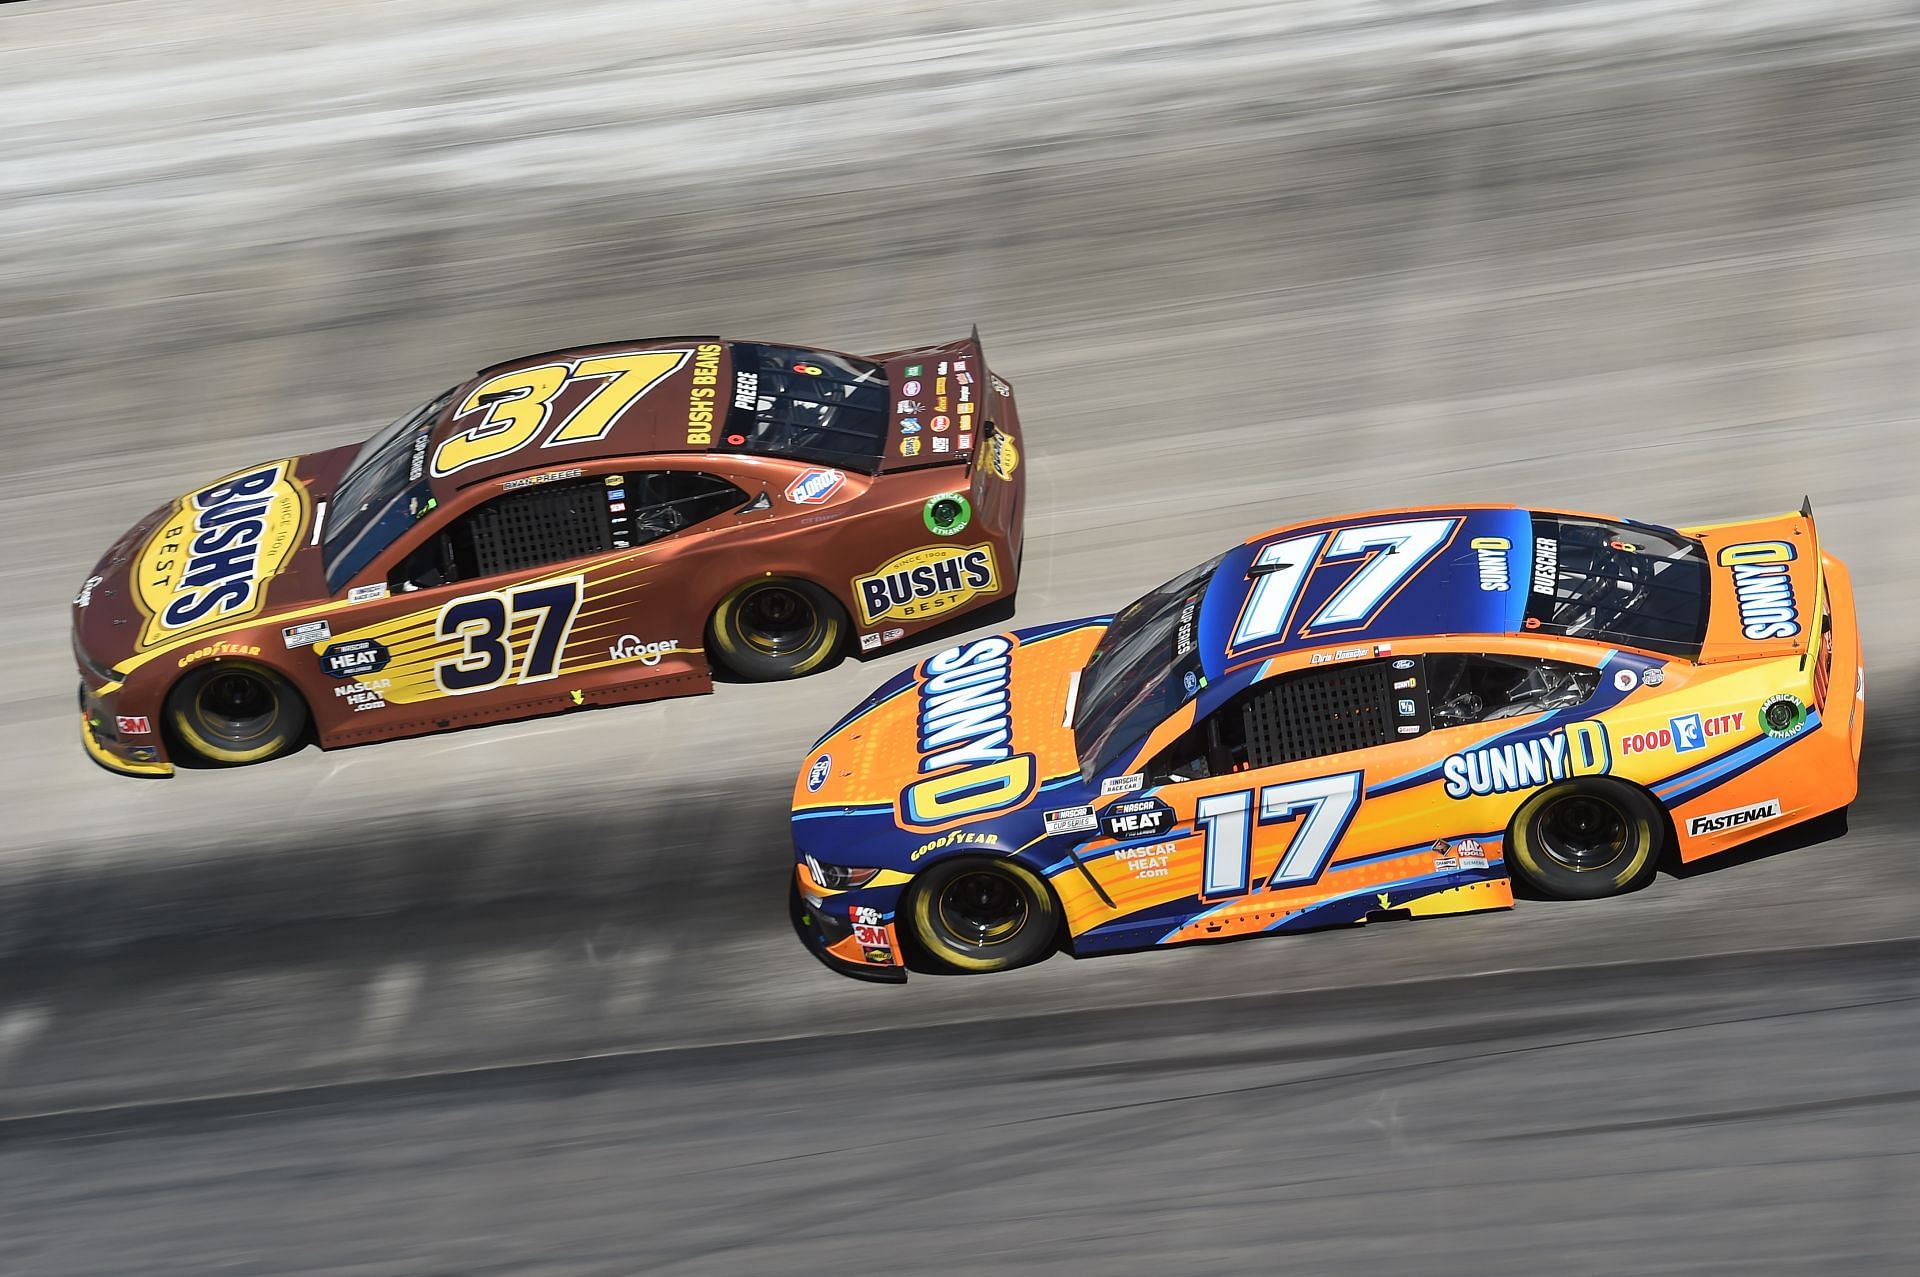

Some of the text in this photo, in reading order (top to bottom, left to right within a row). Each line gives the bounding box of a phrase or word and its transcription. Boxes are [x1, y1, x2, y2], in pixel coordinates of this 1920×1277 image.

[687, 344, 721, 444] BUSH'S BEANS
[735, 371, 758, 411] PREECE
[430, 349, 696, 478] 37
[536, 468, 582, 484] PREECE
[932, 521, 967, 536] ETHANOL
[152, 525, 183, 586] BEST
[162, 466, 281, 627] BUSH'S
[893, 556, 921, 569] SINCE
[1533, 537, 1557, 596] BUESCHER
[861, 551, 991, 618] BUSH'S
[1230, 517, 1460, 653] 17
[904, 595, 959, 615] BEST
[434, 575, 584, 695] 37
[1178, 605, 1195, 655] CUP SERIES
[178, 640, 260, 668] GOODYEAR
[330, 650, 378, 669] HEAT
[609, 634, 679, 666] Kroger
[334, 678, 392, 697] NASCAR
[346, 690, 385, 705] HEAT
[353, 701, 386, 712] .com
[1761, 694, 1802, 713] AMERICAN
[119, 718, 148, 732] 3M
[1623, 729, 1672, 755] FOOD
[1704, 712, 1744, 737] CITY
[1768, 721, 1805, 739] ETHANOL
[1053, 818, 1089, 830] CUP SERIES
[1059, 808, 1087, 820] NASCAR
[1111, 812, 1162, 833] HEAT
[1691, 803, 1777, 835] FASTENAL
[1196, 770, 1364, 899] 17
[911, 830, 998, 862] GOODYEAR
[1114, 843, 1176, 860] NASCAR
[1127, 856, 1168, 871] HEAT
[1135, 868, 1168, 879] .com
[856, 907, 877, 924] K&N
[856, 926, 888, 944] 3M
